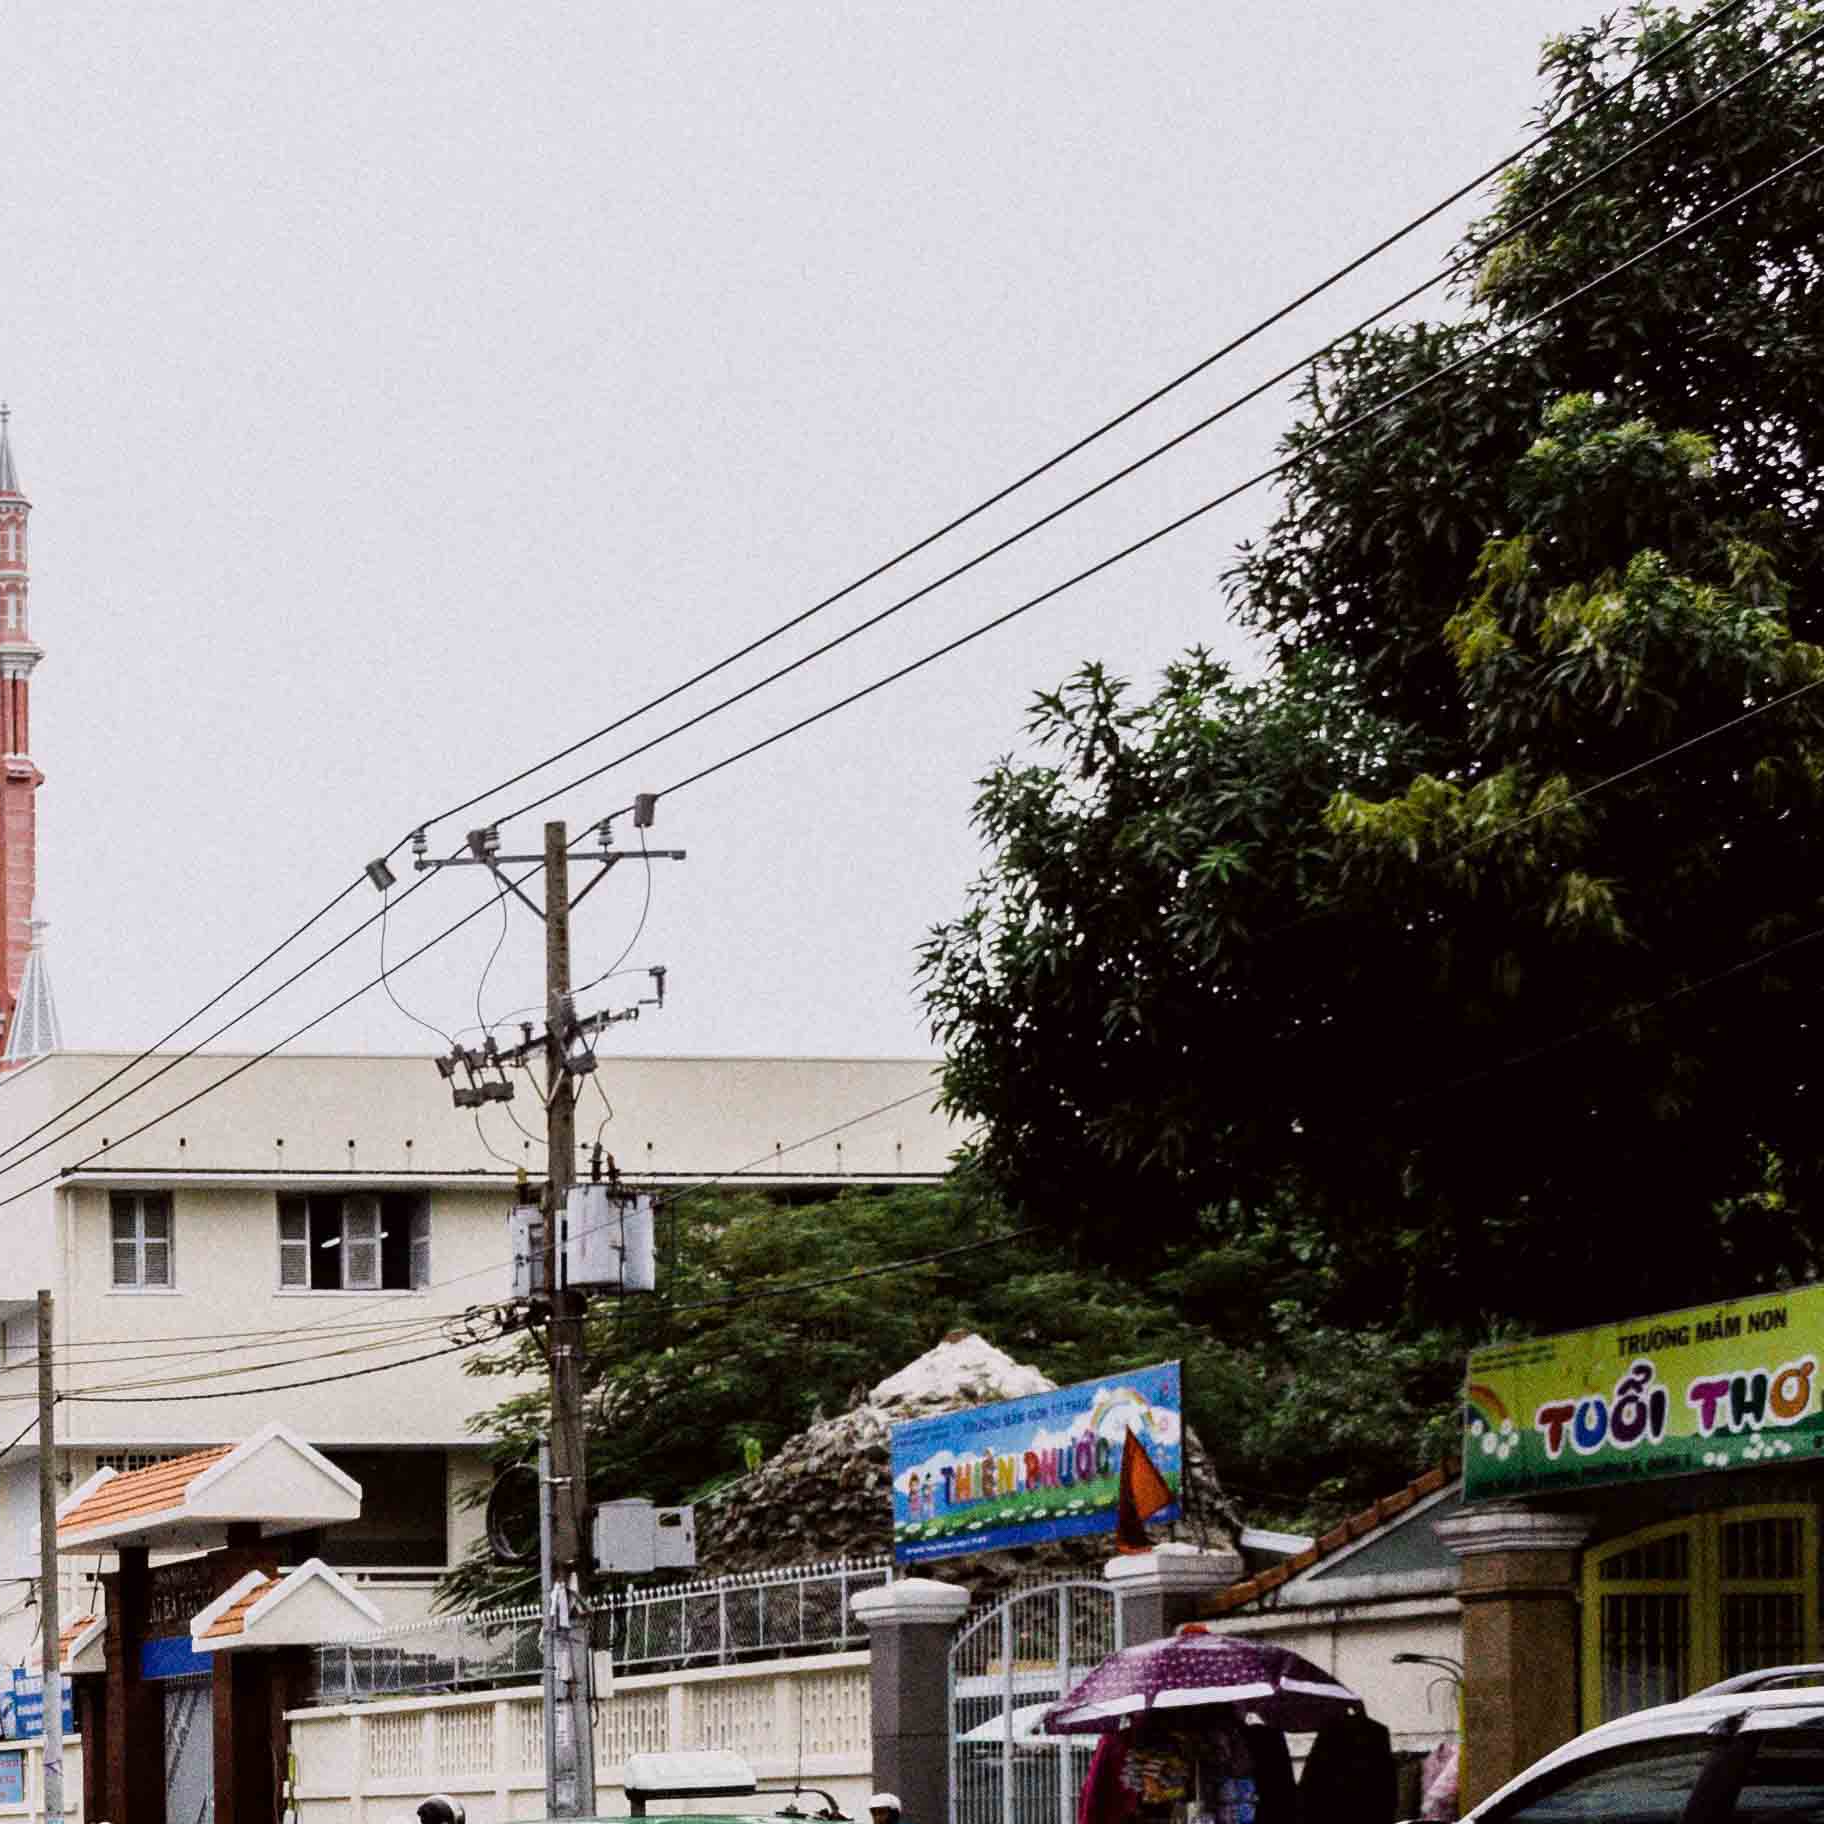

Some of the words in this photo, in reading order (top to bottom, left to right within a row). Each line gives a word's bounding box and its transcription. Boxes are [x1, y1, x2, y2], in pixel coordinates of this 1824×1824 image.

[1618, 1325, 1689, 1358] TRƯỜNG
[1747, 1307, 1788, 1333] NON
[1537, 1360, 1666, 1459] TUỔI
[1689, 1355, 1816, 1437] THƠ
[940, 1448, 1016, 1507] THIÊN
